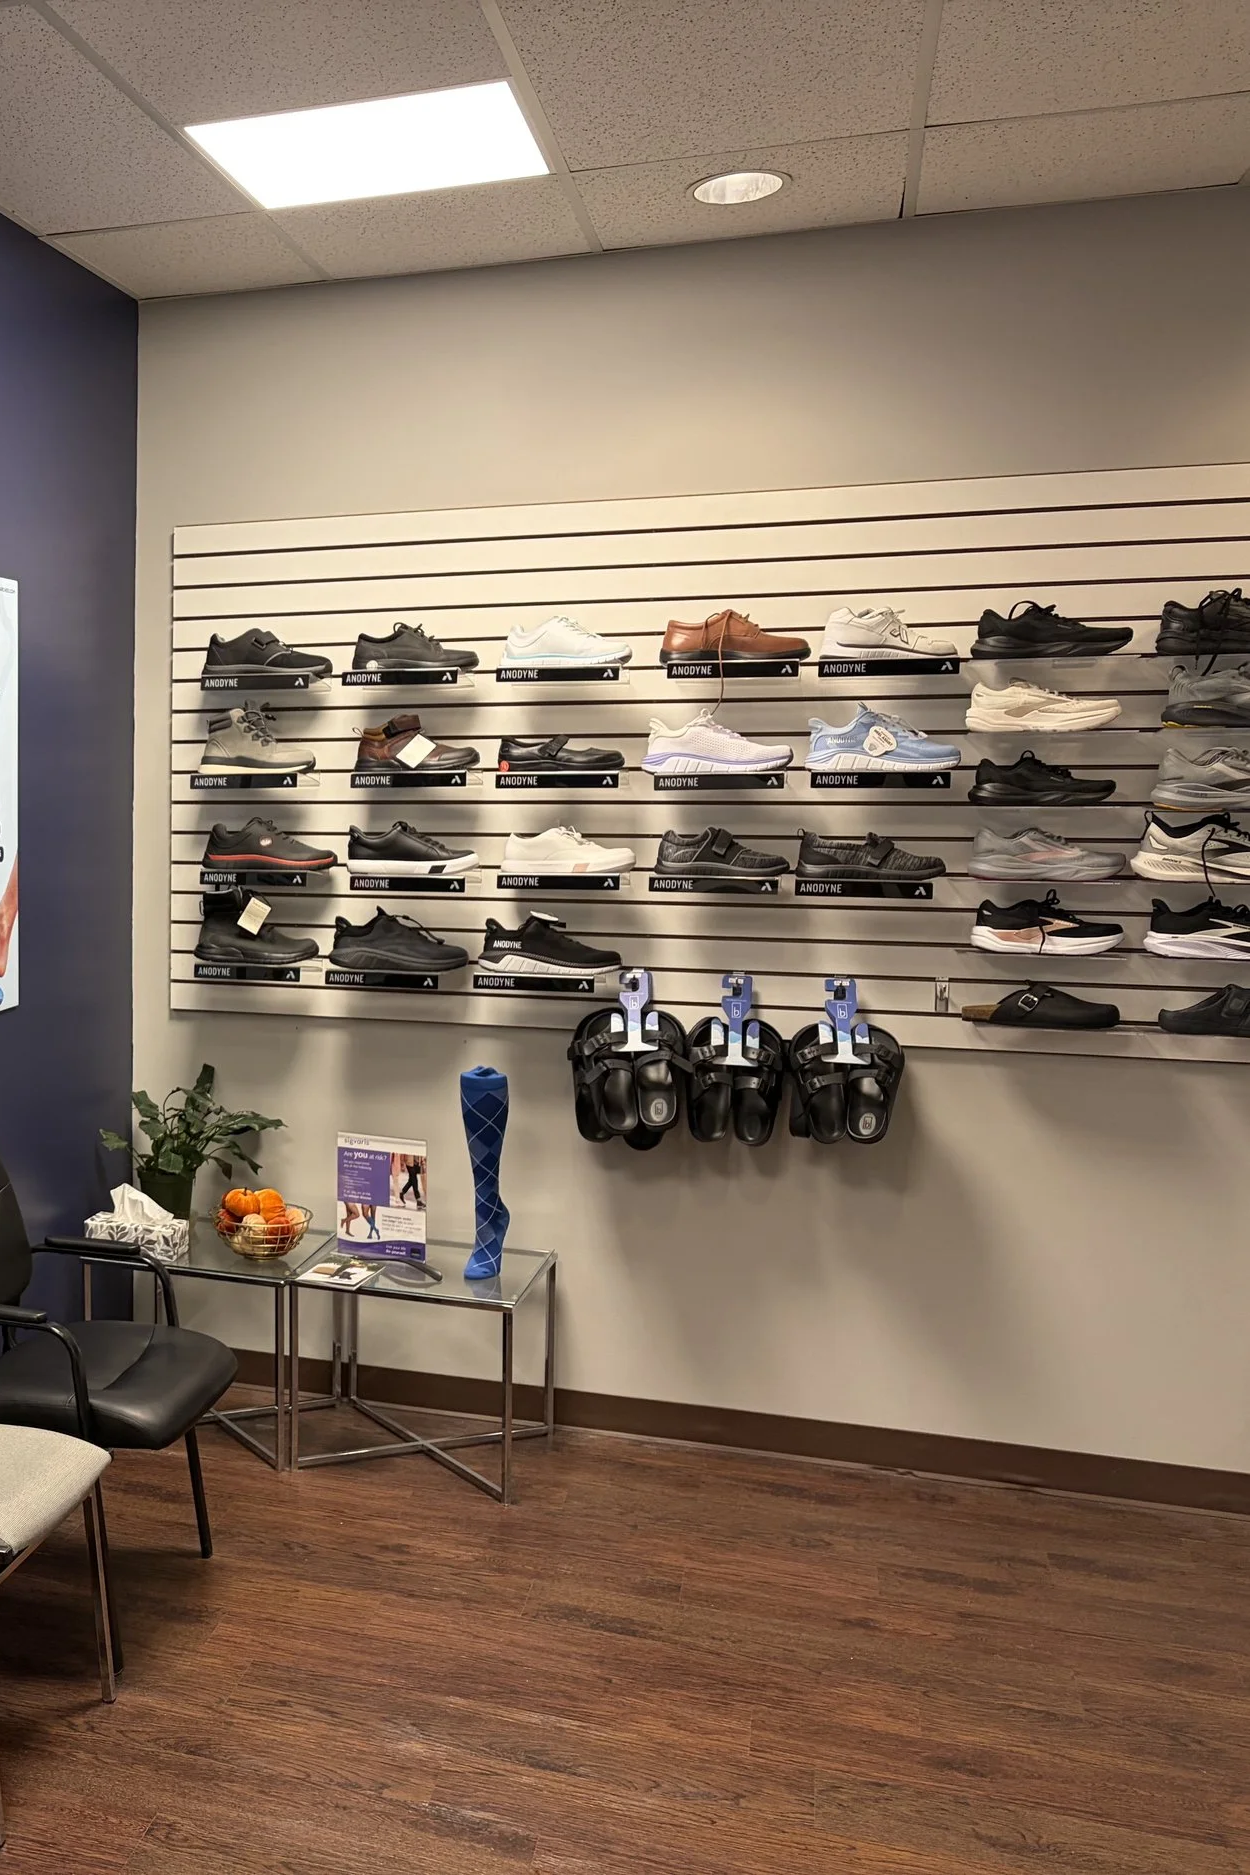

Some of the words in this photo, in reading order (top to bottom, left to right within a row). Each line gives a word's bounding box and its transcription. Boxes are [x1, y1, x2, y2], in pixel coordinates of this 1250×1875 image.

[500, 668, 538, 680] ANODYNE
[672, 665, 712, 676] ANODYNE
[823, 664, 867, 674] ANODYNE
[204, 678, 238, 688] ANODYNE
[346, 673, 382, 684] ANODYNE
[194, 776, 227, 786] ANODYNE
[355, 775, 391, 786] ANODYNE
[500, 776, 538, 786] ANODYNE
[659, 777, 699, 788] ANODYNE
[816, 775, 858, 785] ANODYNE
[204, 872, 237, 883] ANODYNE
[501, 876, 539, 887] ANODYNE
[354, 878, 390, 888] ANODYNE
[653, 879, 693, 890] ANODYNE
[800, 883, 842, 893] ANODYNE
[493, 940, 522, 949] ANODYNE
[198, 966, 231, 976] ANODYNE
[329, 973, 364, 983] ANODYNE
[478, 977, 515, 988] ANODYNE
[354, 1151, 368, 1159] you
